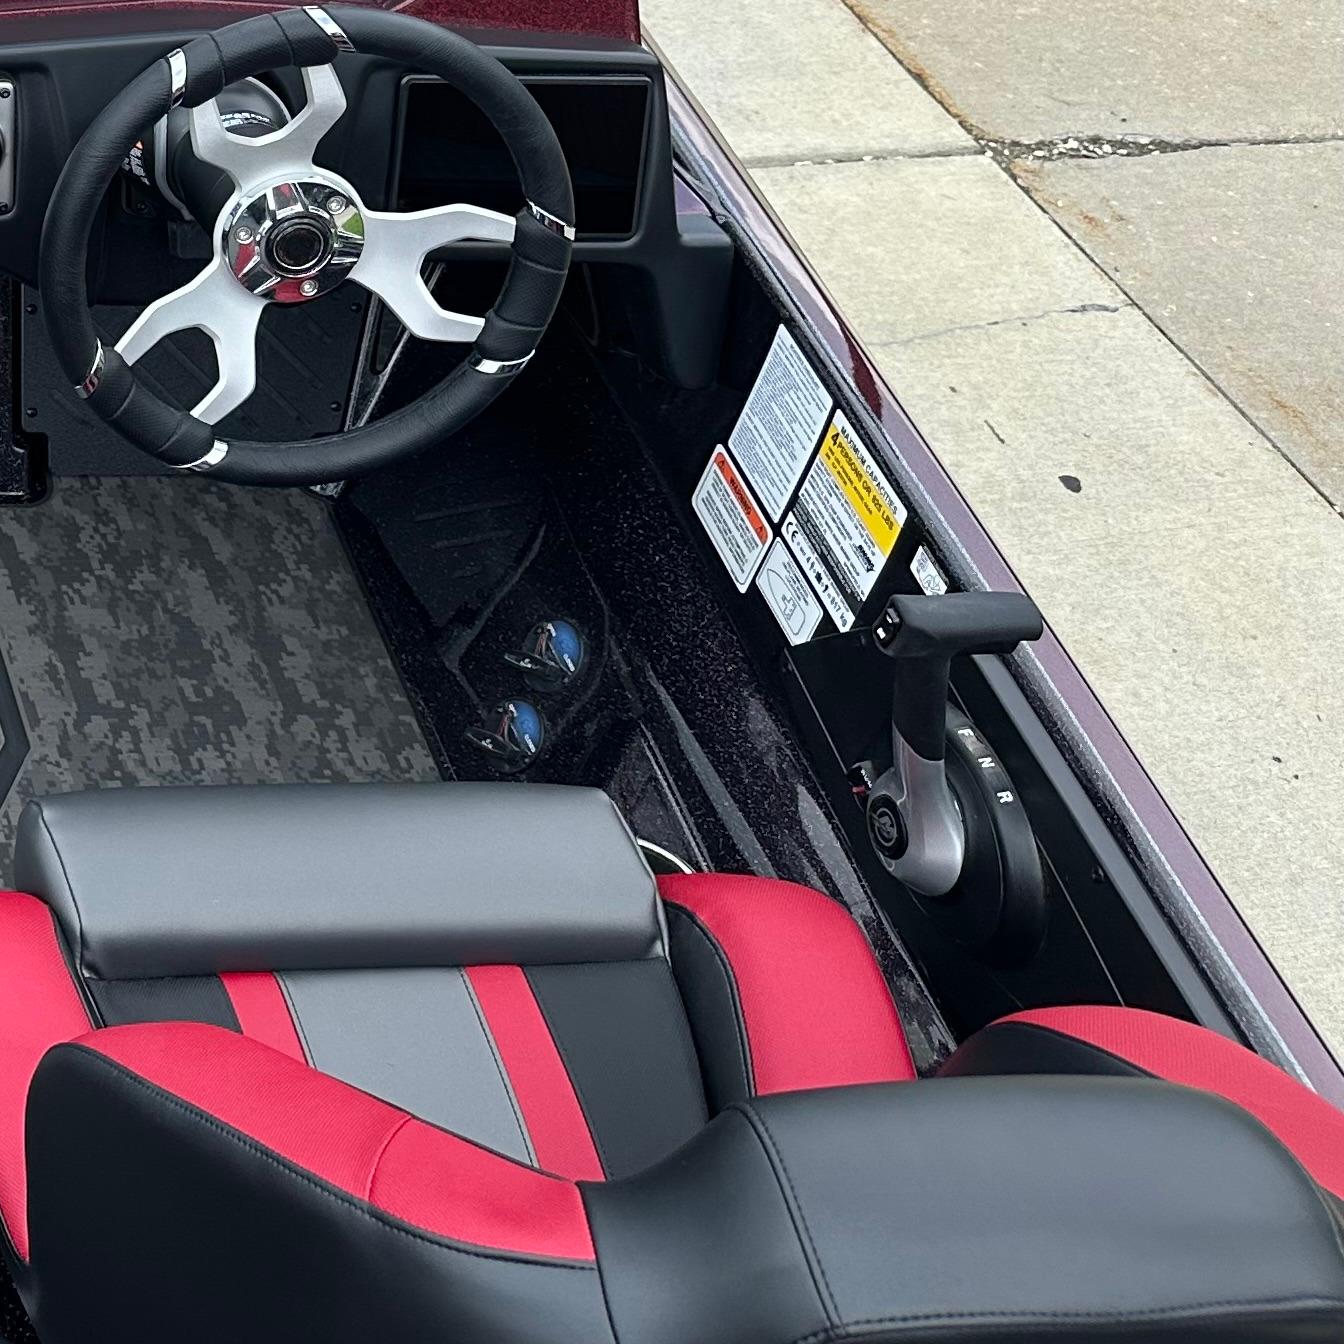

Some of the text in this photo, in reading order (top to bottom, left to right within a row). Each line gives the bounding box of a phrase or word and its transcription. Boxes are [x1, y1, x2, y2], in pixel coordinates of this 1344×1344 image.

[829, 428, 840, 447] 4
[836, 440, 863, 483] PERSONS
[840, 425, 866, 467] MAXIMUM
[864, 463, 898, 516] CAPACITIES
[958, 728, 975, 738] F
[978, 757, 995, 769] N
[997, 791, 1013, 803] R
